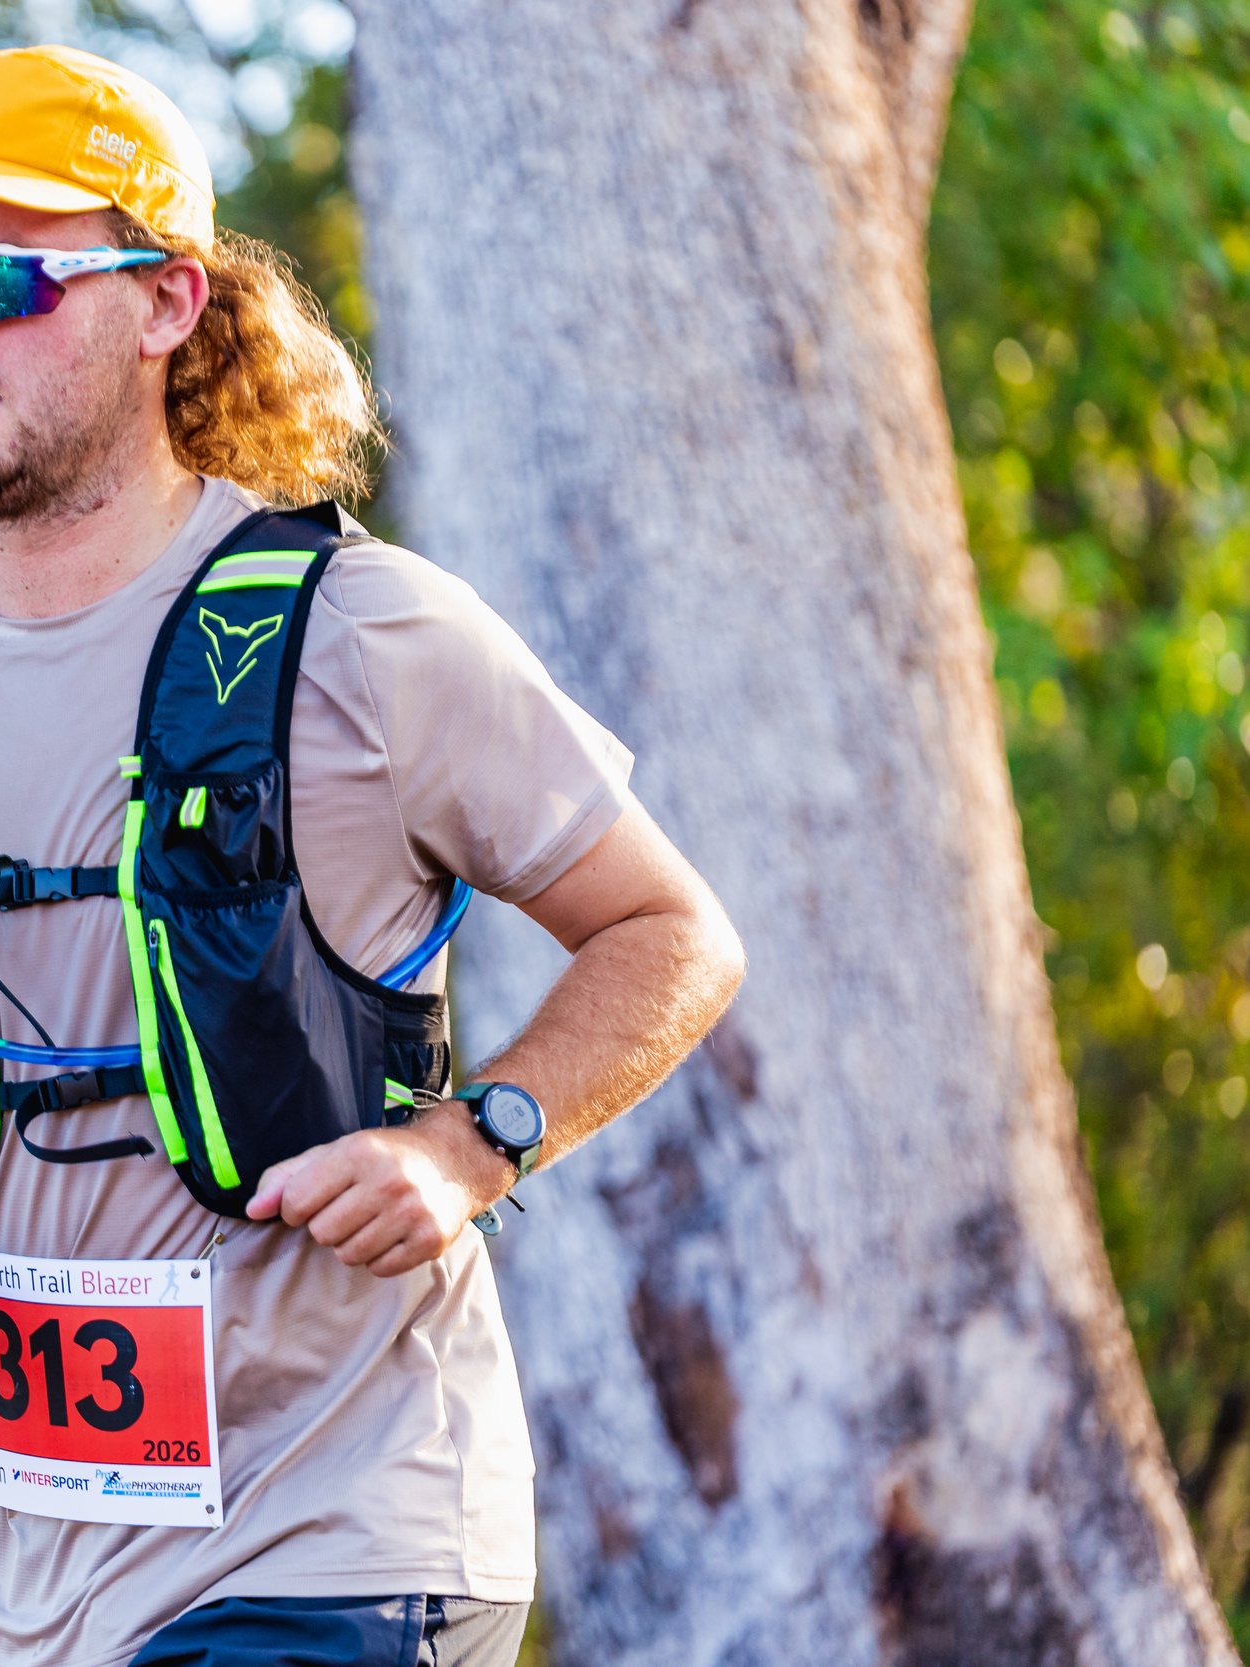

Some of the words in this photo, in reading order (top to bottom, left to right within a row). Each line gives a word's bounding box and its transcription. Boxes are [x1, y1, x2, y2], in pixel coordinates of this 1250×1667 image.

[28, 1267, 71, 1293] Trail
[82, 1271, 152, 1295] Blazer
[143, 1440, 201, 1462] 2026
[21, 1470, 89, 1491] INTERSPORT
